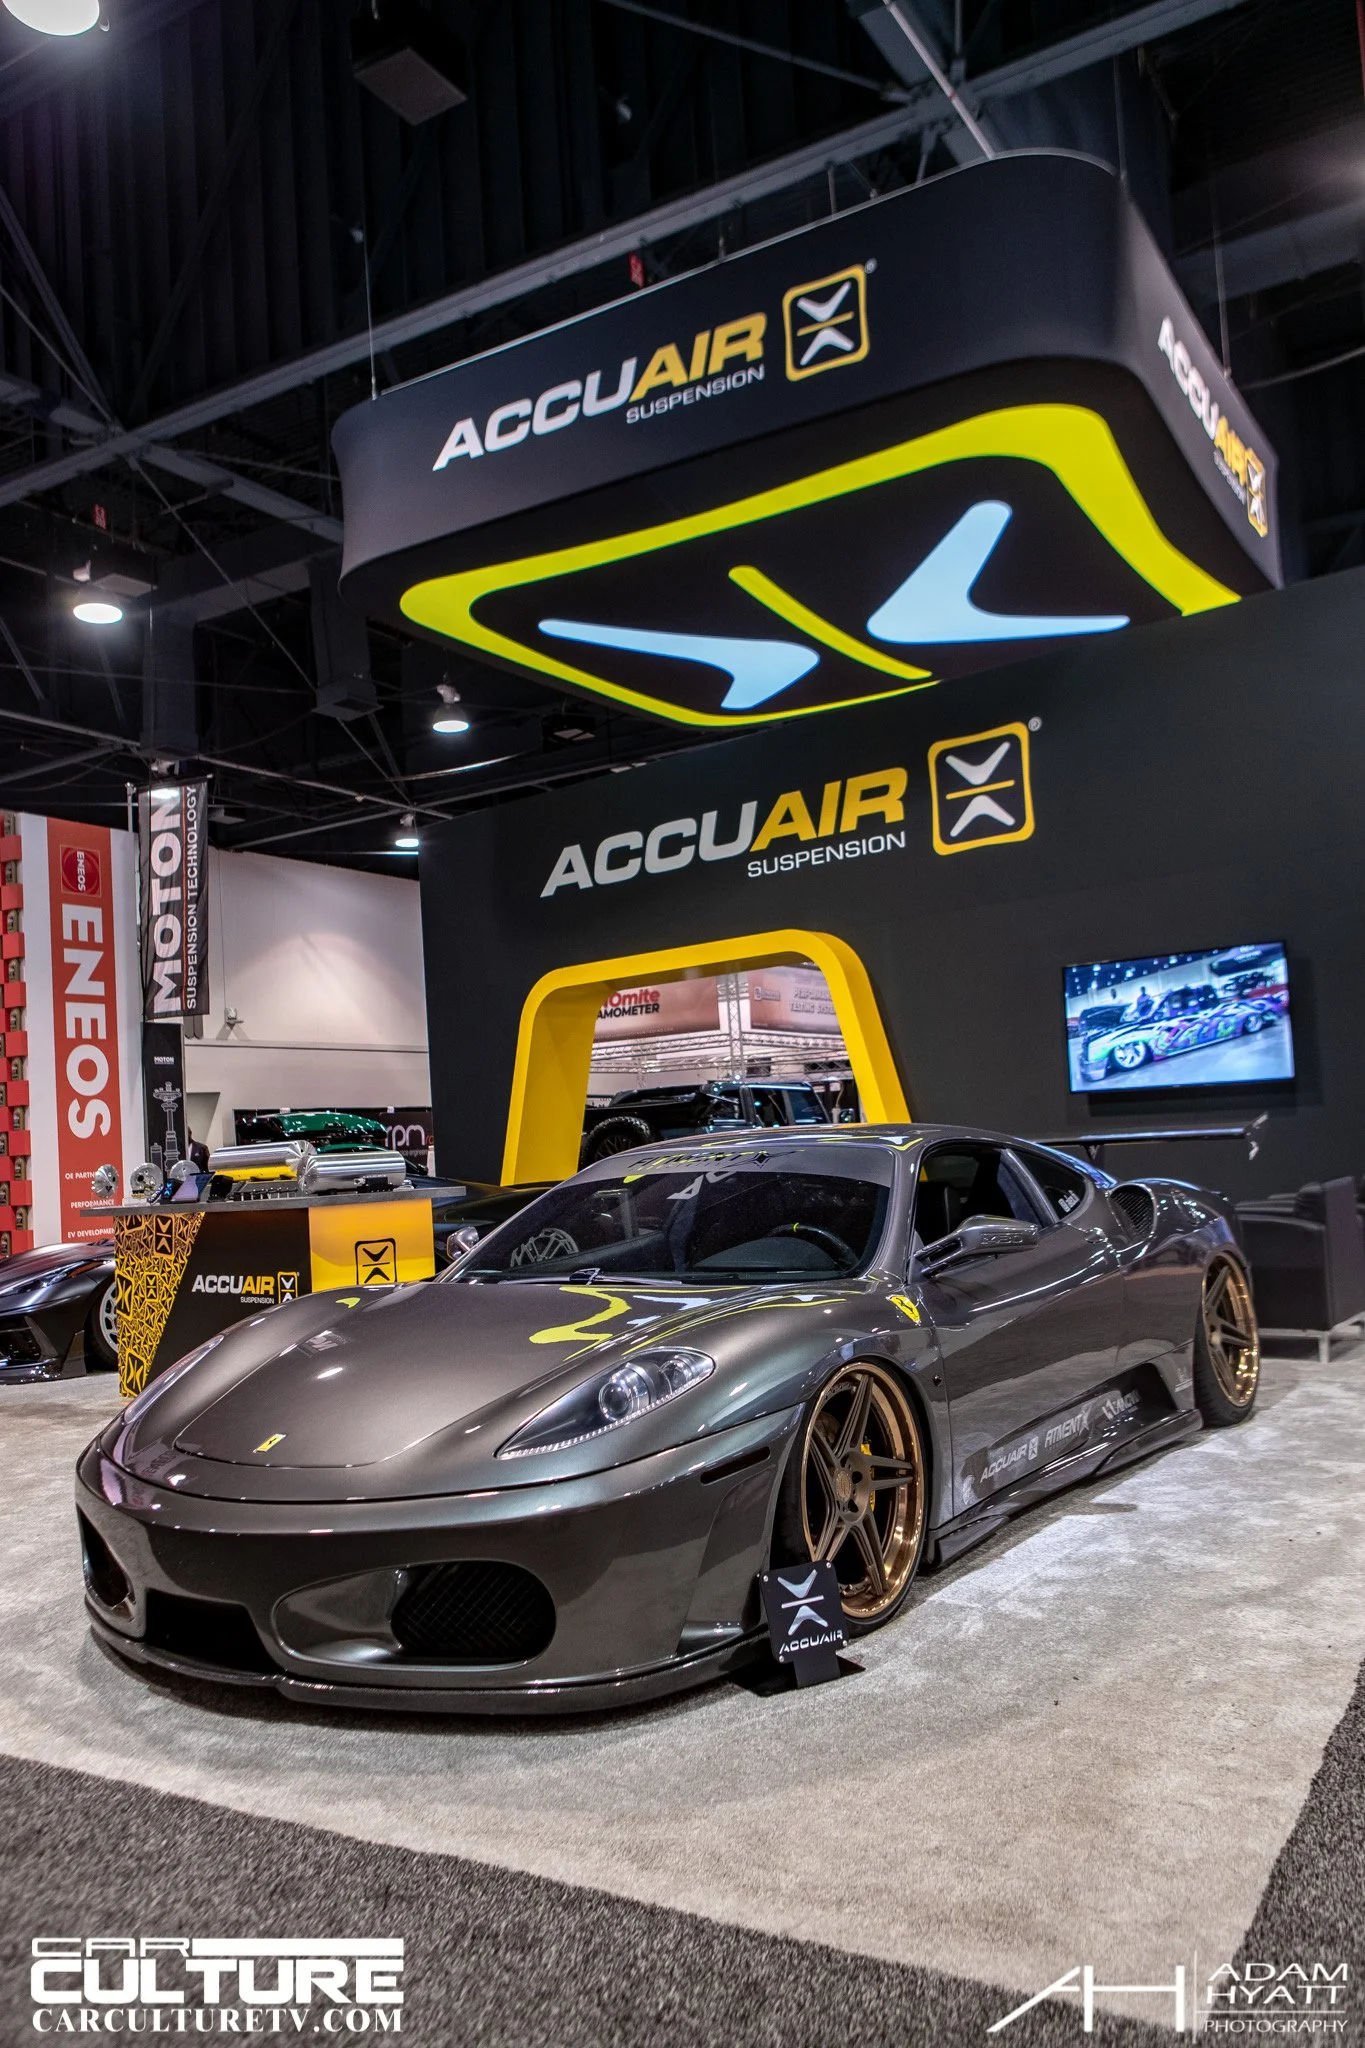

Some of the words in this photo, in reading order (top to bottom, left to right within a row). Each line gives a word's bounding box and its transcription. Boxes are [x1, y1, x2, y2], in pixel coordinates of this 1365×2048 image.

[432, 312, 767, 471] ACCUAIR
[626, 364, 765, 424] SUSPENSION
[1157, 315, 1248, 487] ACCUAIR
[186, 785, 198, 899] TECHNOLOGY
[540, 767, 908, 898] ACCUAIR
[747, 831, 906, 878] SUSPENSION
[76, 851, 86, 892] ENEOS
[151, 788, 182, 1014] MOTON
[186, 904, 198, 1009] SUSPENSION
[62, 903, 112, 1140] ENEOS
[65, 1172, 74, 1180] OE
[75, 1171, 96, 1179] PARTN
[70, 1200, 114, 1208] PERFORMANCE
[77, 1228, 115, 1237] DEVELOPMEN
[191, 1275, 275, 1295] ACCUAIR
[240, 1296, 275, 1304] SUSPENSION
[980, 1444, 1028, 1484] ACCUAIR
[779, 1629, 843, 1655] ACCUAIR
